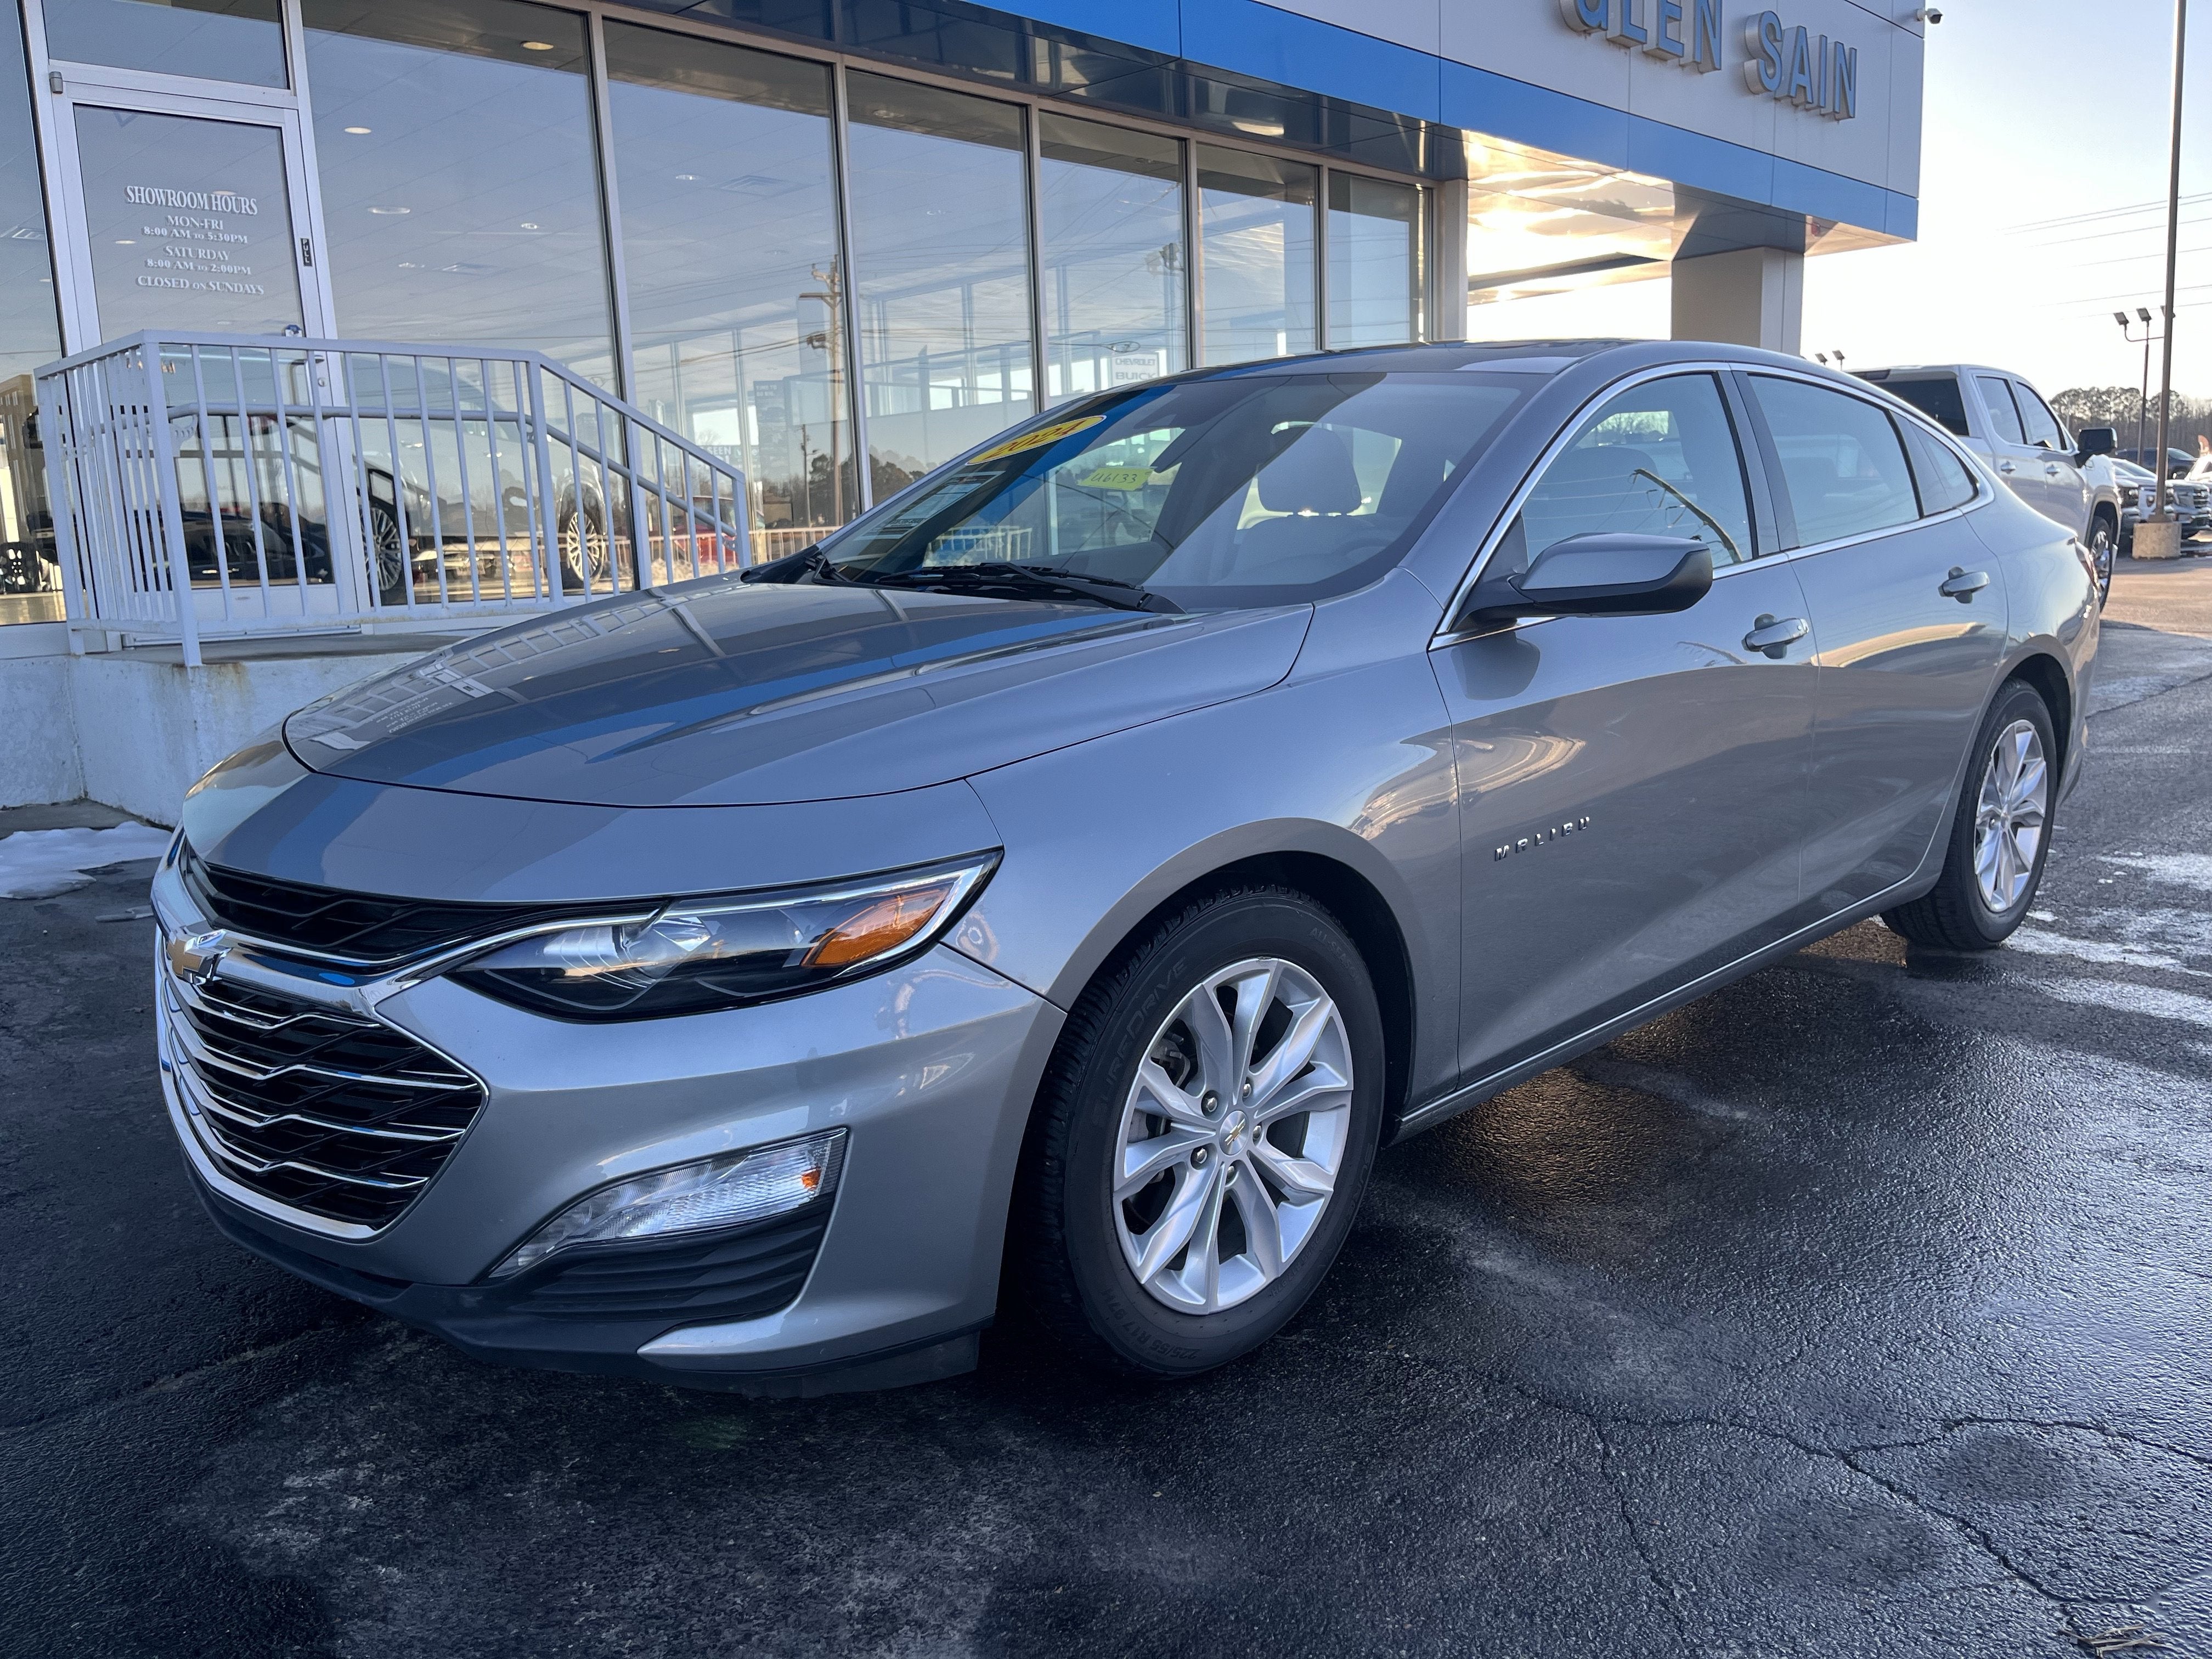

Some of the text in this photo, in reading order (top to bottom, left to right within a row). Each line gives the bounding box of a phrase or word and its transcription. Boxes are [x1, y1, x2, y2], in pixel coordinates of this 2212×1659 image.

[1749, 10, 1857, 119] SAIN
[127, 185, 258, 215] SHOWROOM HOURS
[167, 215, 224, 230] MON-FRI
[144, 226, 167, 236] 8:00
[171, 229, 190, 238] AM
[207, 232, 247, 244] 5:30PM
[166, 246, 230, 261] SATURDAY
[147, 258, 170, 268] 8:00
[173, 261, 193, 270] AM
[210, 264, 251, 274] 2:00PM
[138, 275, 189, 289] CLOSED
[209, 280, 264, 295] SUNDAYS
[983, 420, 1087, 461] 2024
[1494, 816, 1590, 862] MALIBU
